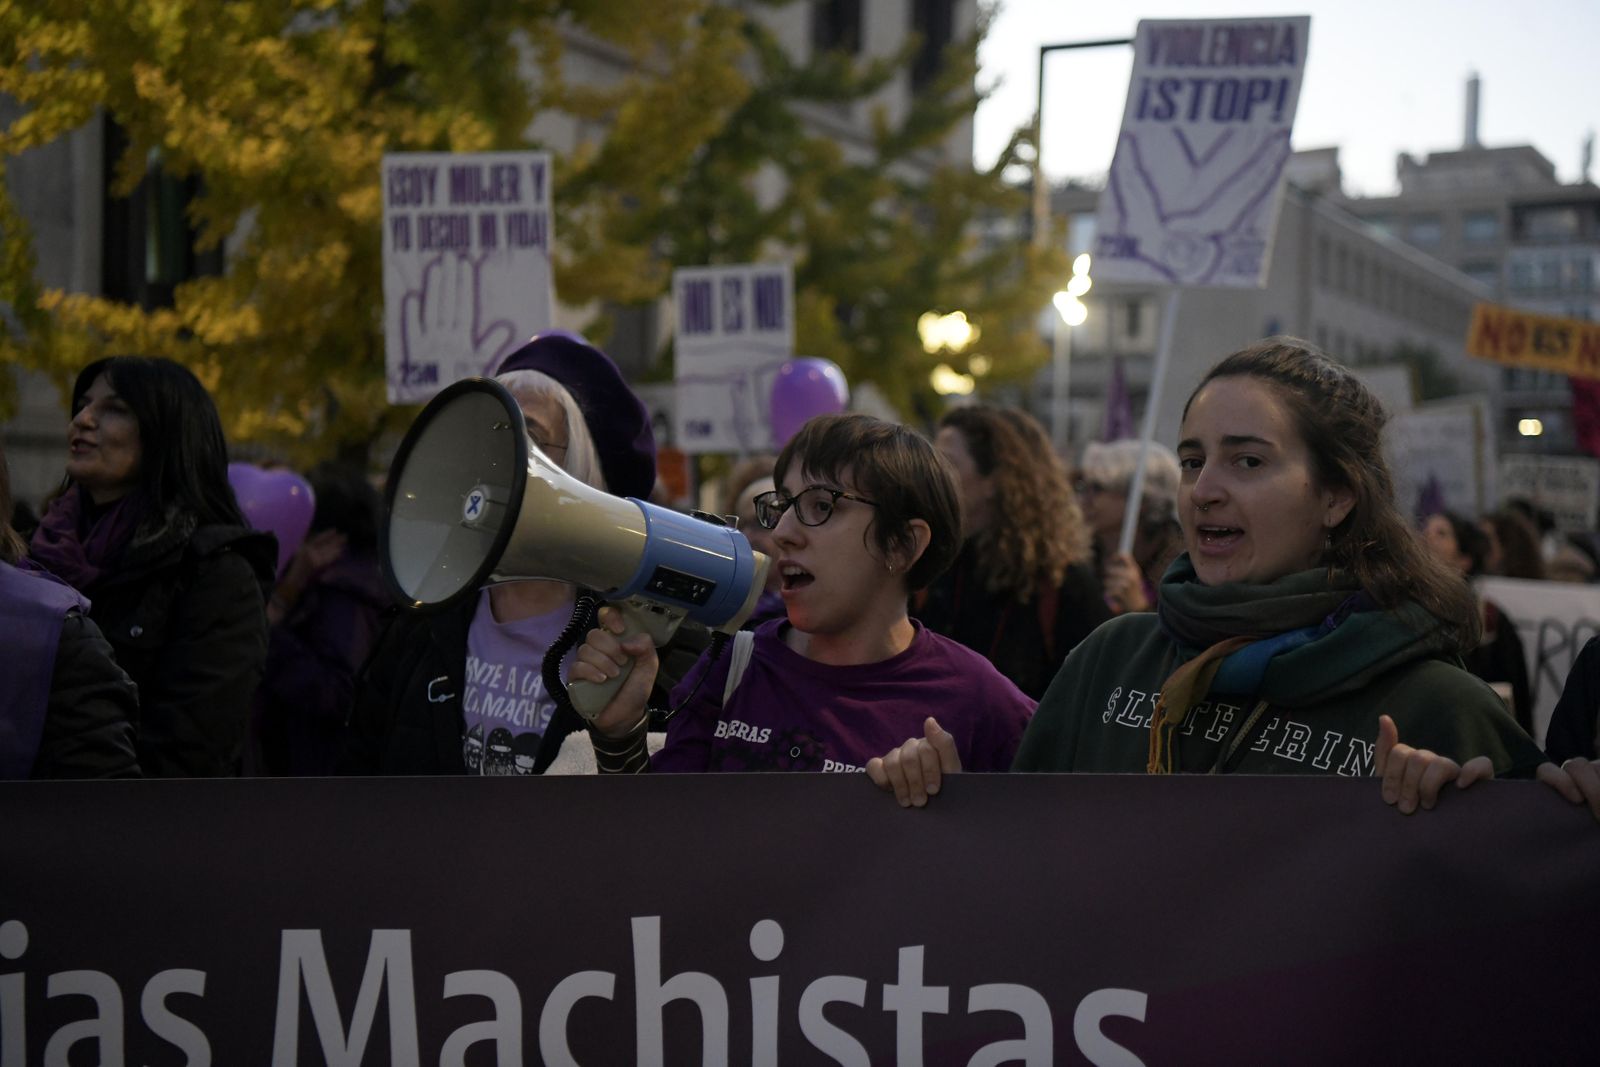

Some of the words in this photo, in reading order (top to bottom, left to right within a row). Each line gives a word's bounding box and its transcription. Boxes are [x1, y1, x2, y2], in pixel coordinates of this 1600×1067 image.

[1146, 25, 1296, 66] VIOLENCIA
[449, 164, 519, 204] MUJER
[531, 162, 545, 202] Y
[1478, 310, 1527, 358] NO
[505, 666, 517, 694] A
[1102, 685, 1377, 778] SLTHERIN
[270, 915, 1149, 1067] Machistas
